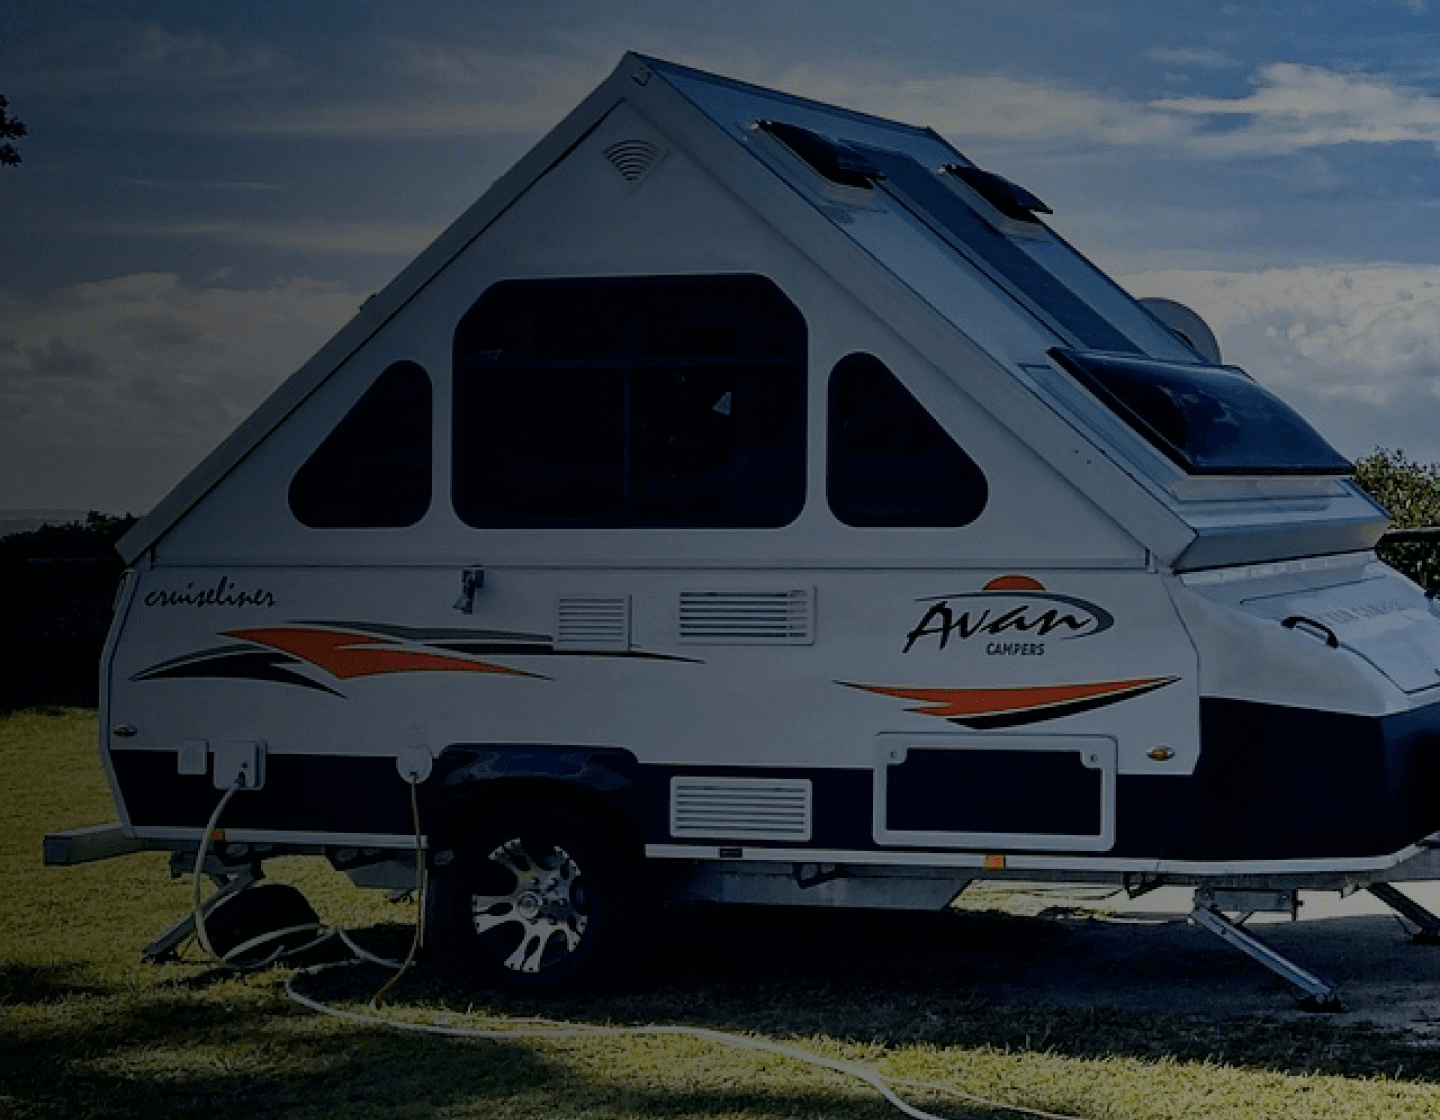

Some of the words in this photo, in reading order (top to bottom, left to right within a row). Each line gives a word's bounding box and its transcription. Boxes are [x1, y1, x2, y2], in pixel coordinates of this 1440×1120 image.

[144, 575, 277, 609] cruiseliner
[901, 600, 1092, 654] Avan
[985, 642, 1046, 656] CAMPERS
